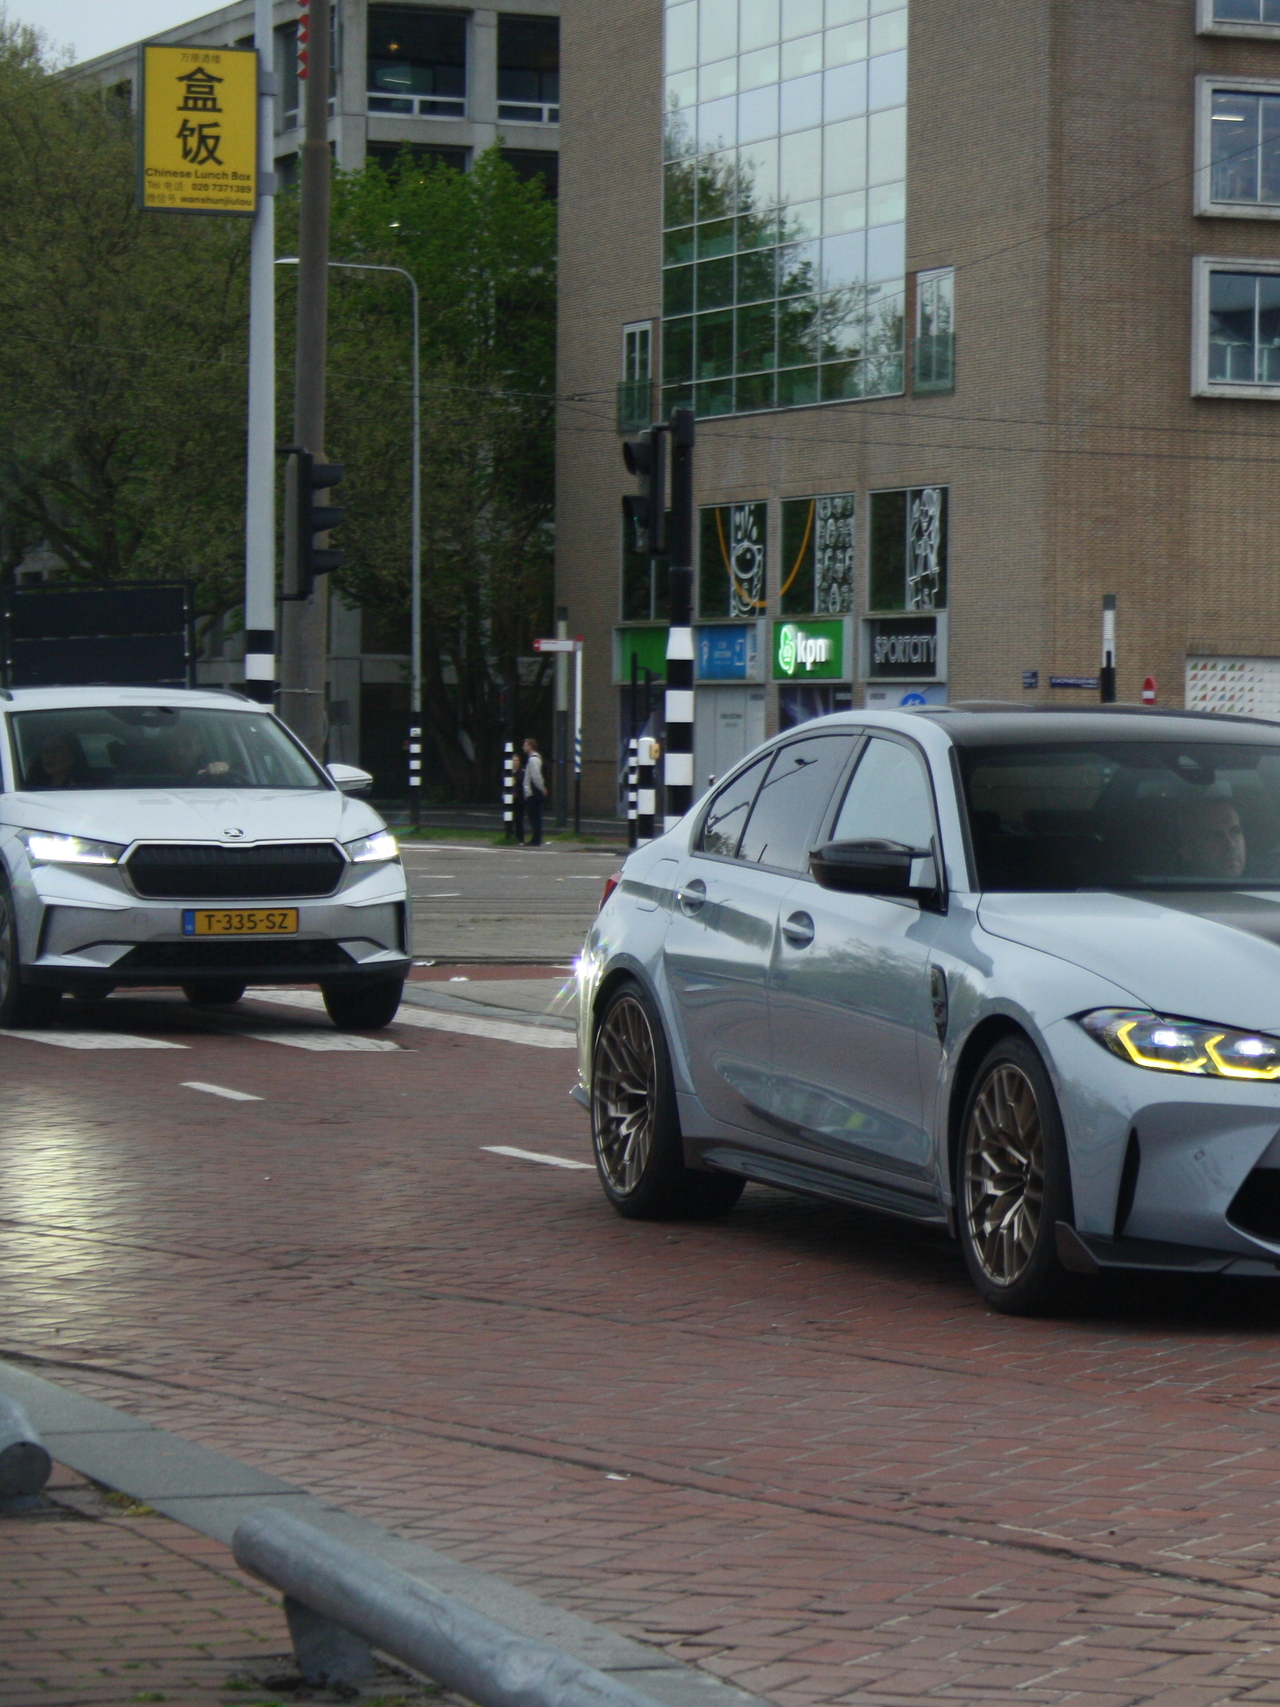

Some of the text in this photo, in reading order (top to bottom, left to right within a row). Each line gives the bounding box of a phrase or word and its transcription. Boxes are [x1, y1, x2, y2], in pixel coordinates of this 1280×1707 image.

[176, 66, 224, 166] 盒饭
[145, 167, 251, 181] Chinese Lunch Box
[192, 183, 209, 191] 020
[797, 632, 828, 671] kpn
[875, 635, 937, 663] SPORTCITY
[204, 912, 288, 931] T-335-SZ
